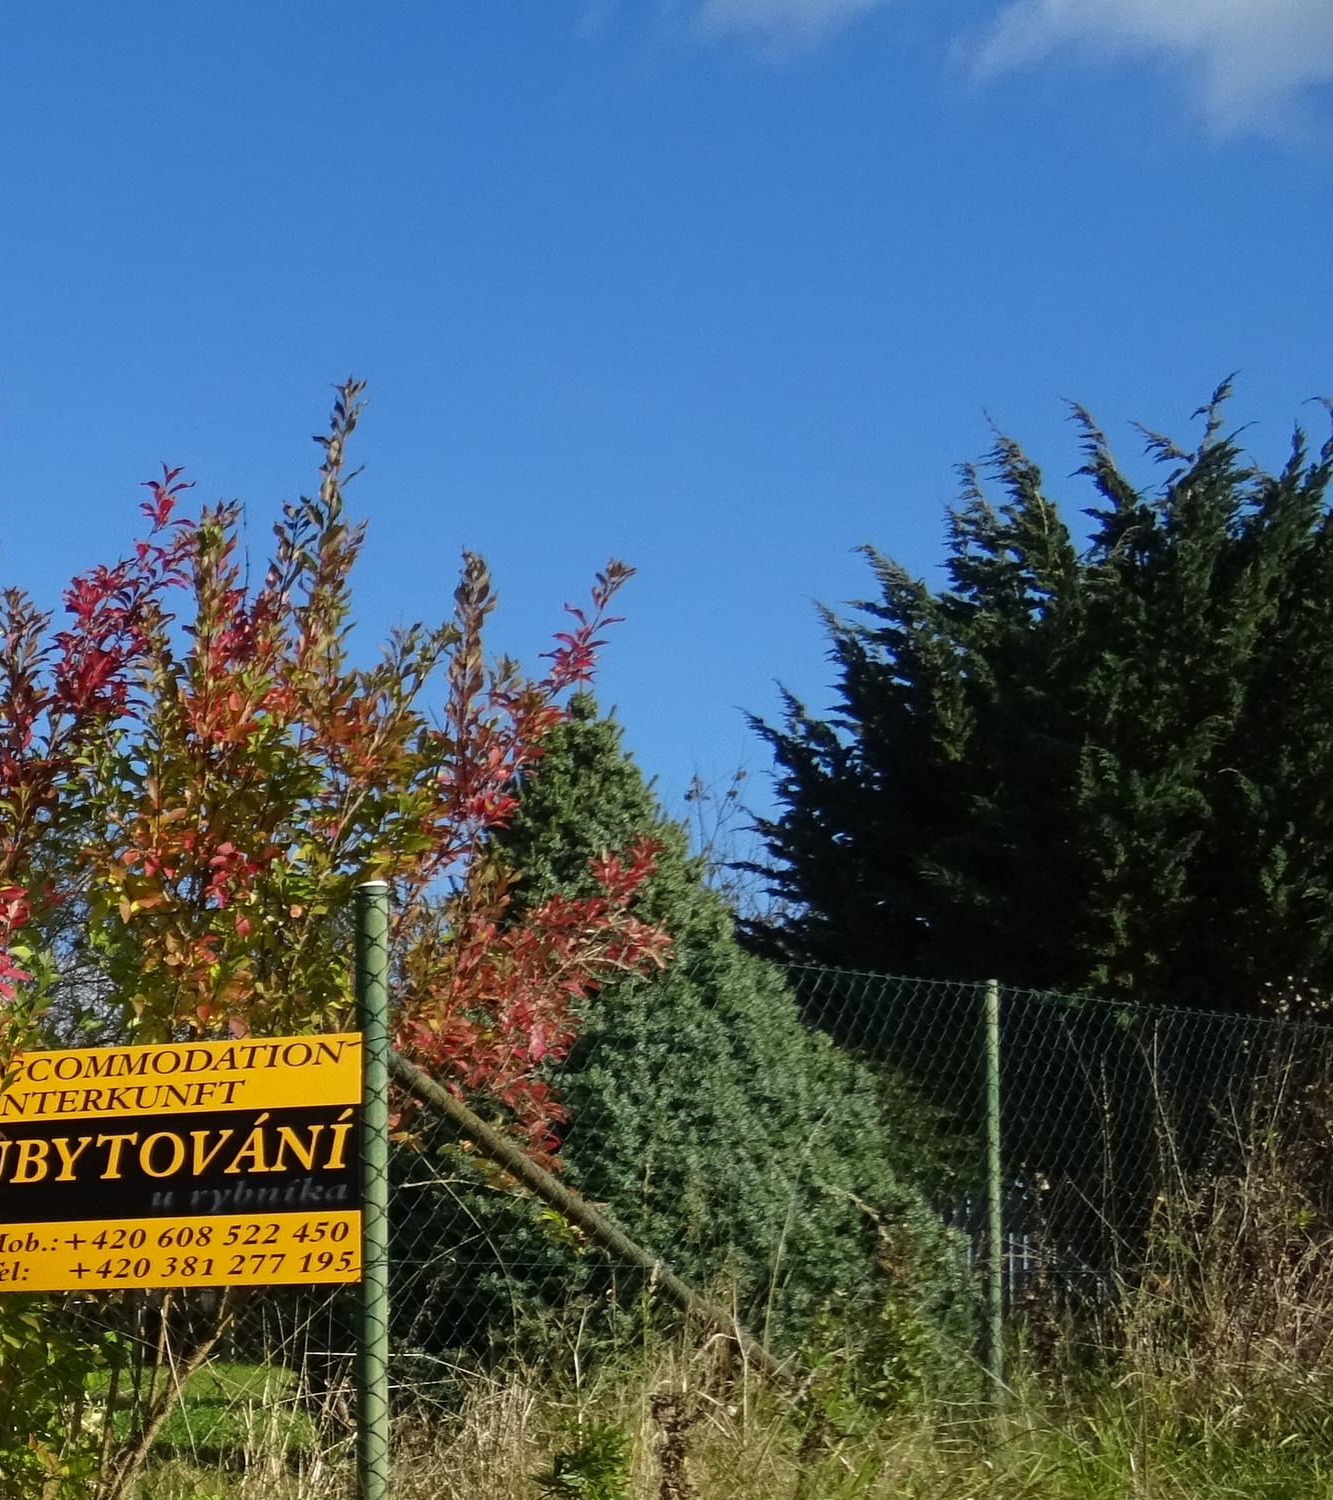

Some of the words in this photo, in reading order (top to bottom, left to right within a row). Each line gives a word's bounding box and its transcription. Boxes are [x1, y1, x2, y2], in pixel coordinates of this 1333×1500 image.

[157, 1225, 214, 1248] 608
[222, 1223, 281, 1246] 522
[292, 1221, 350, 1244] 450
[69, 1257, 151, 1280] +420
[160, 1255, 215, 1278] 381
[227, 1253, 286, 1275] 277
[297, 1250, 354, 1273] 195
